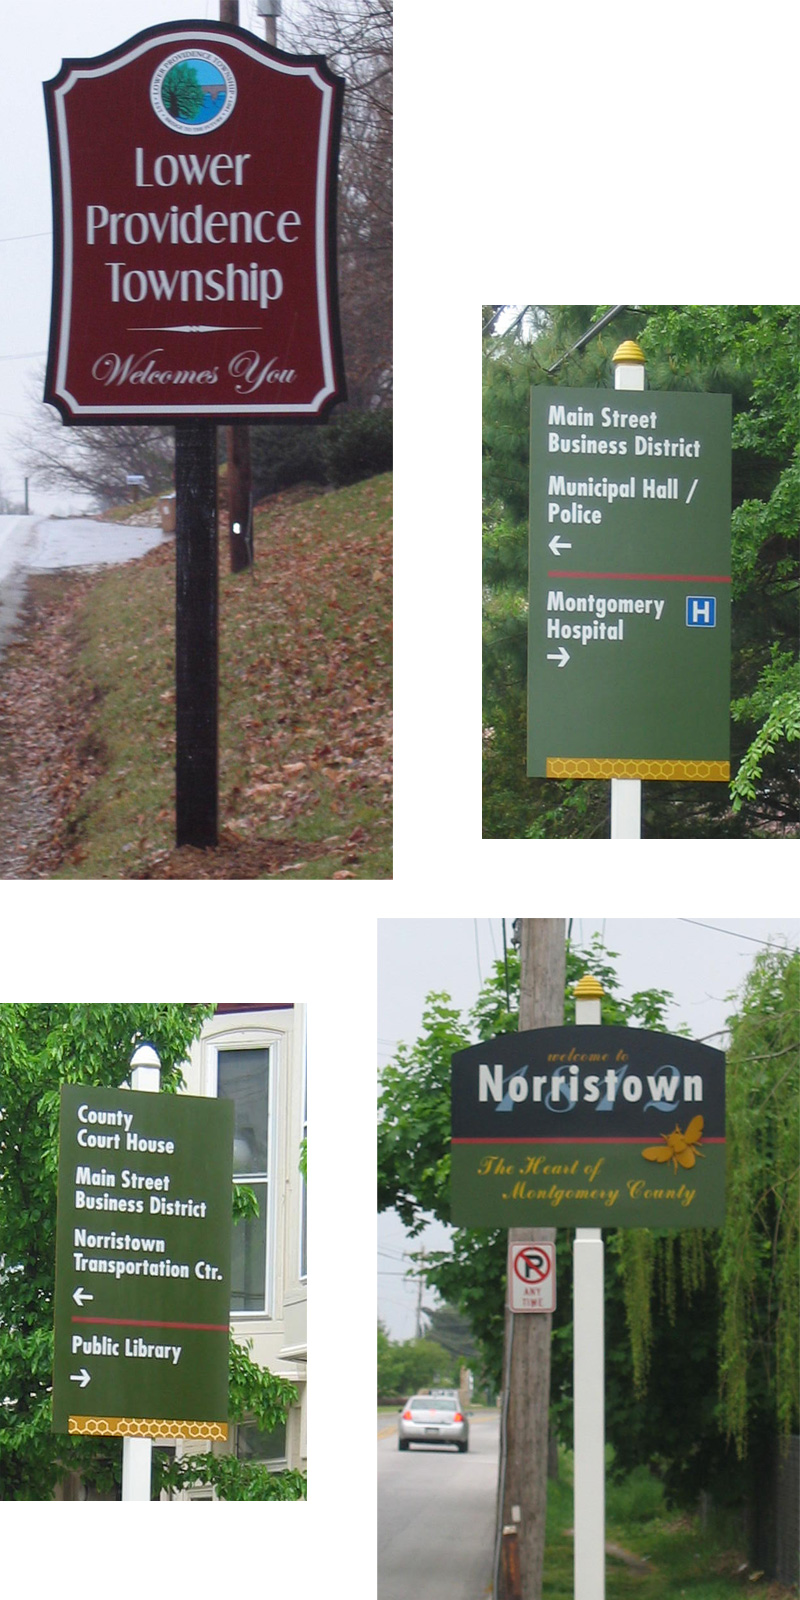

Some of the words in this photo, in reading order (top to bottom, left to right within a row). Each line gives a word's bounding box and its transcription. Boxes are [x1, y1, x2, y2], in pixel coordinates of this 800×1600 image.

[153, 69, 165, 95] LOWER
[164, 51, 211, 68] PROVIDENCE
[136, 148, 250, 187] Lower
[86, 205, 301, 244] Providence
[105, 262, 283, 309] Township
[92, 348, 219, 386] Welcomes
[228, 350, 297, 394] You
[548, 405, 594, 426] Main
[601, 407, 657, 429] Street
[549, 432, 627, 455] Business
[635, 436, 700, 458] District
[548, 475, 635, 503] Municipal
[643, 478, 678, 499] Hall
[686, 479, 698, 504] /
[548, 502, 602, 524] Police
[547, 591, 664, 620] Montgomery
[692, 601, 709, 623] H
[547, 619, 623, 645] Hospital
[547, 1048, 609, 1062] welcome
[616, 1049, 629, 1061] to
[479, 1064, 703, 1102] Norristown
[78, 1105, 133, 1131] County
[77, 1129, 120, 1149] Court
[127, 1133, 175, 1154] House
[76, 1166, 115, 1187] Main
[121, 1170, 170, 1191] Street
[477, 1155, 514, 1175] The
[520, 1155, 578, 1175] Heart
[584, 1157, 605, 1182] of
[75, 1191, 144, 1213] Business
[150, 1196, 206, 1218] District
[502, 1181, 619, 1207] Montgomery
[627, 1179, 696, 1206] County
[74, 1229, 165, 1253] Norristown
[73, 1253, 189, 1279] Transportation
[195, 1261, 223, 1281] Ctr.
[524, 1287, 541, 1295] ANY
[72, 1335, 120, 1356] Public
[125, 1338, 182, 1364] Library
